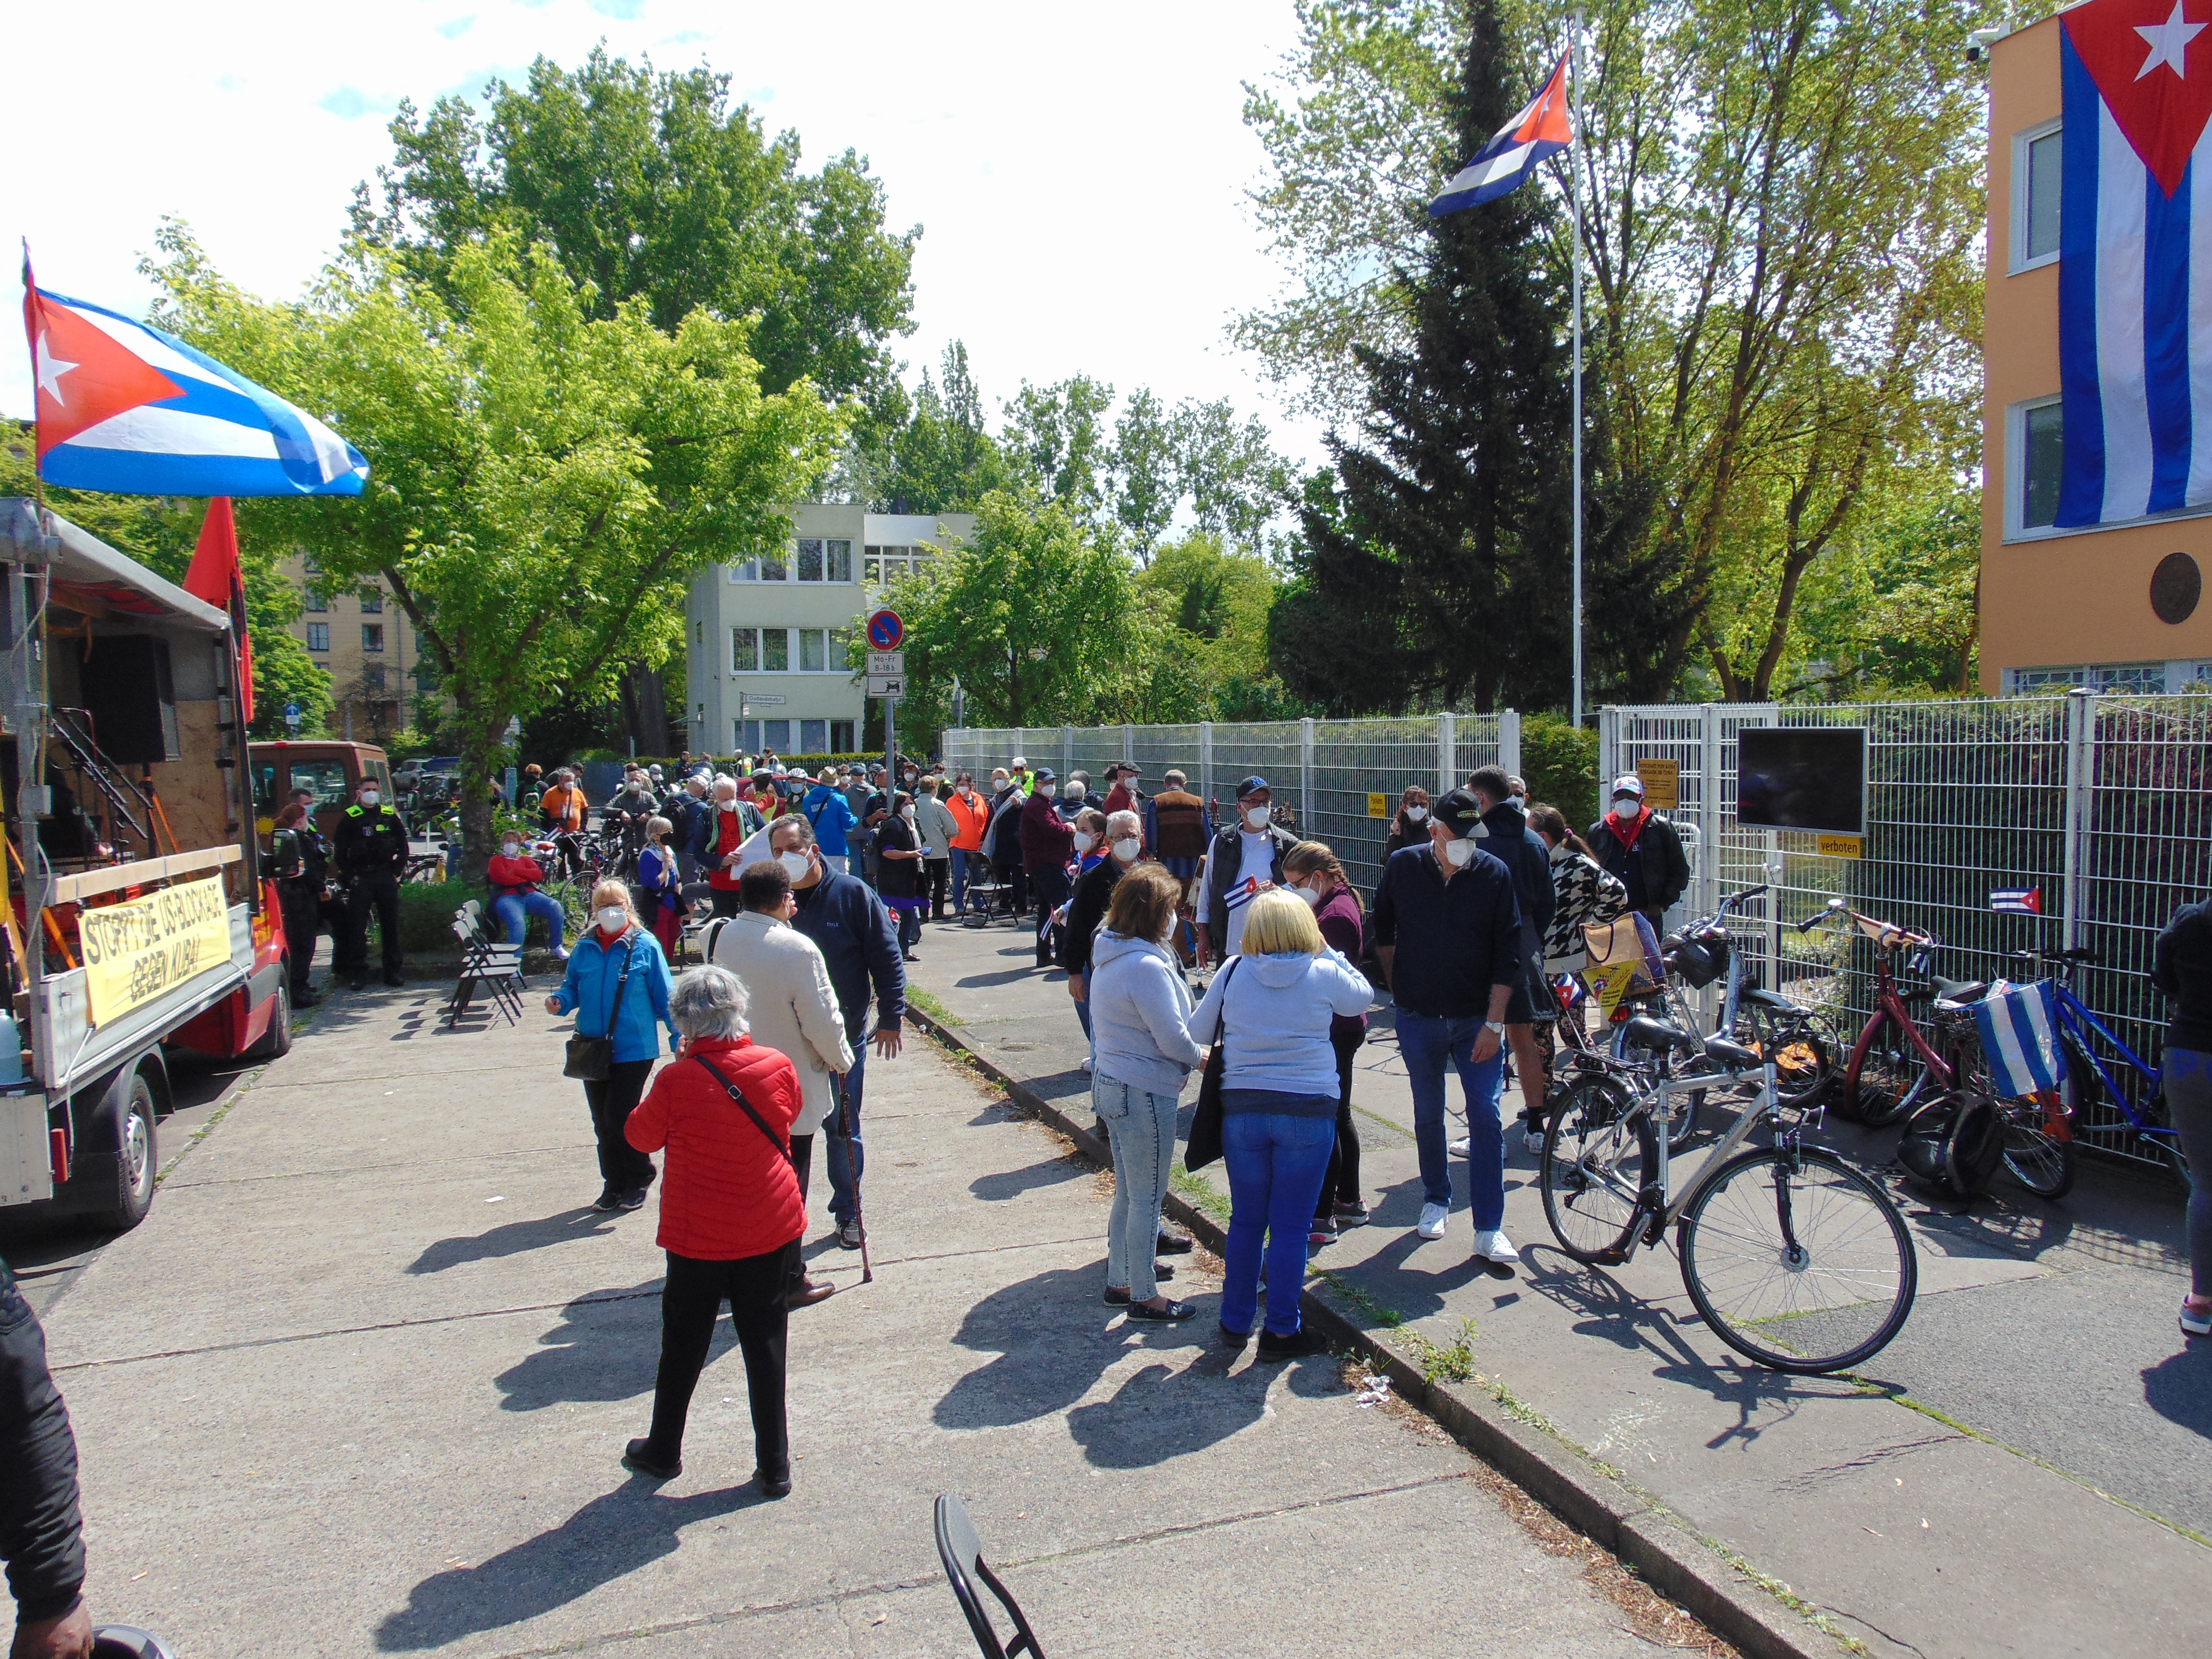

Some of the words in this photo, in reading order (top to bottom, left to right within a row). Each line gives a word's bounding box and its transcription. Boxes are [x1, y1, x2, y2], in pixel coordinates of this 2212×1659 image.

[1370, 796, 1382, 804] Parken
[1370, 806, 1384, 814] verboten
[1821, 840, 1857, 854] verboten
[85, 908, 138, 965] STOPPT
[135, 902, 161, 947] DIE
[158, 883, 222, 936] US-BLOCKADE
[130, 947, 168, 1003] GEGEN
[169, 933, 201, 984] KUBA!
